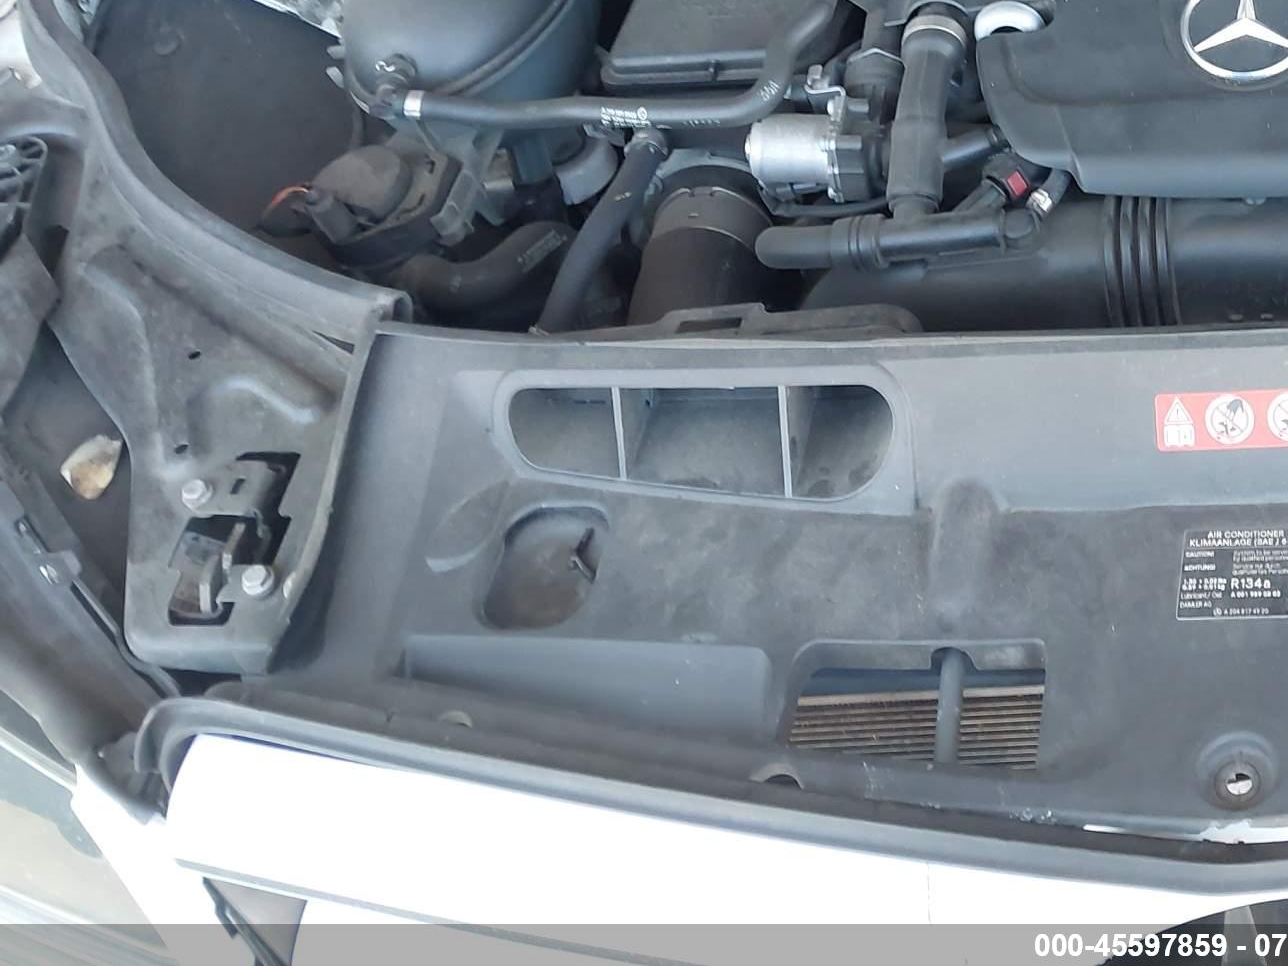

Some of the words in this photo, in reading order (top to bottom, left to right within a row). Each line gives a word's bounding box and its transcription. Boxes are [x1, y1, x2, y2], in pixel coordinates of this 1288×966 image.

[1207, 530, 1222, 538] AIR
[1224, 530, 1284, 538] CONDITIONER
[1189, 538, 1252, 547] KLIMAANLAGE
[1230, 577, 1271, 590] R134a
